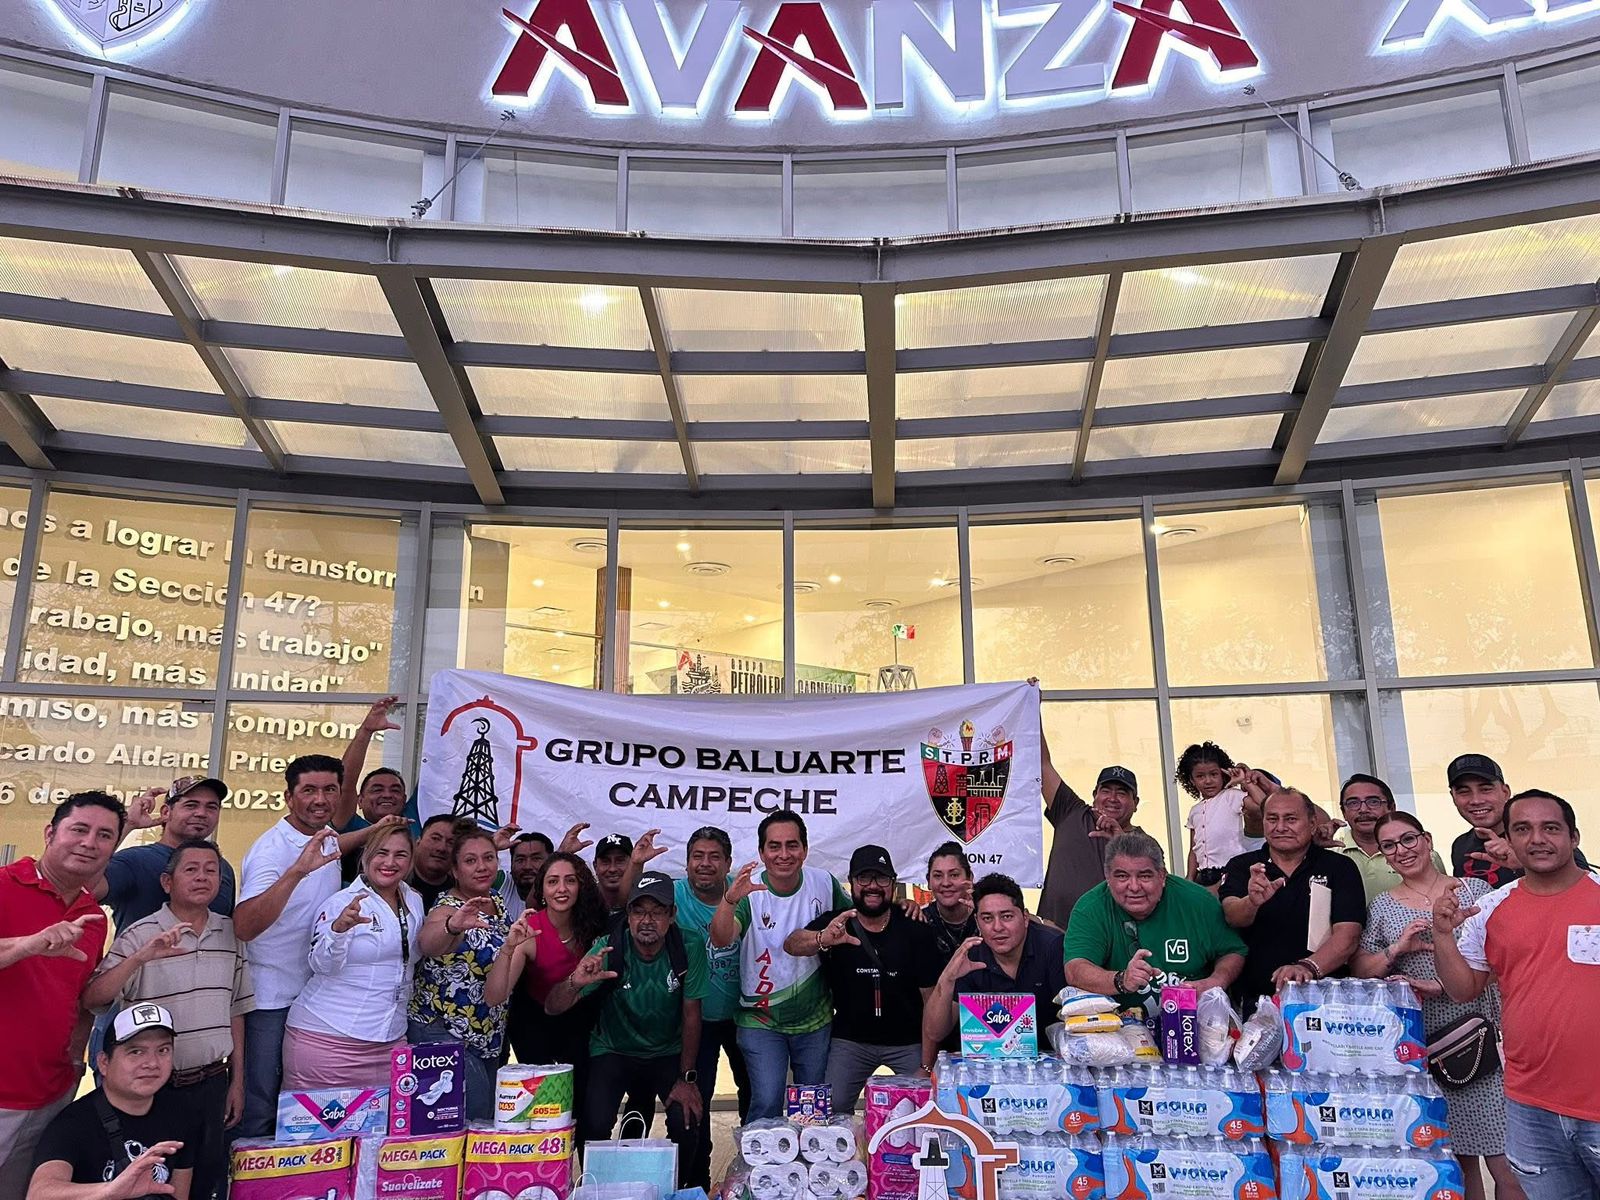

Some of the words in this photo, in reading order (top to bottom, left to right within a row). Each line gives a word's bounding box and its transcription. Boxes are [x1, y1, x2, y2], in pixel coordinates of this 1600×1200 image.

[491, 0, 1262, 113] AVANZA
[70, 519, 93, 539] a
[106, 519, 215, 556] lograr
[66, 560, 99, 588] la
[264, 591, 321, 617] 47?
[29, 605, 163, 642] rabajo,
[257, 629, 383, 665] trabajo"
[21, 645, 117, 683] idad,
[131, 660, 207, 685] más
[233, 670, 344, 693] nidad"
[731, 658, 764, 672] GRUPO
[121, 703, 200, 729] más
[545, 738, 686, 769] GRUPO
[696, 747, 905, 775] BALUARTE
[28, 782, 71, 804] de
[221, 788, 286, 811] 2023
[608, 782, 838, 815] CAMPECHE
[606, 834, 622, 845] NY
[988, 855, 1003, 865] 47
[986, 1009, 1012, 1025] Saba
[1182, 1015, 1196, 1053] kotex
[1324, 1021, 1386, 1037] water
[1398, 1044, 1410, 1055] 18
[412, 1054, 456, 1071] kotex
[498, 1101, 516, 1111] MAX
[532, 1107, 549, 1115] 605
[998, 1098, 1048, 1113] agua
[1156, 1101, 1208, 1116] agua
[321, 1107, 347, 1121] Saba
[1069, 1112, 1081, 1122] 45
[1338, 1107, 1394, 1125] agua
[1230, 1120, 1243, 1129] 45
[1420, 1126, 1432, 1135] 45
[471, 1141, 507, 1155] MEGA
[509, 1143, 535, 1154] PACK
[538, 1137, 561, 1155] 48
[236, 1155, 276, 1172] MEGA
[278, 1155, 307, 1168] PACK
[310, 1147, 337, 1165] 48
[381, 1149, 418, 1163] MEGA
[420, 1149, 447, 1160] PACK
[1006, 1160, 1056, 1177] gua
[1168, 1167, 1229, 1182] water
[1076, 1176, 1088, 1186] 45
[1244, 1181, 1258, 1192] 45
[1352, 1174, 1418, 1189] water
[1437, 1190, 1452, 1200] 45
